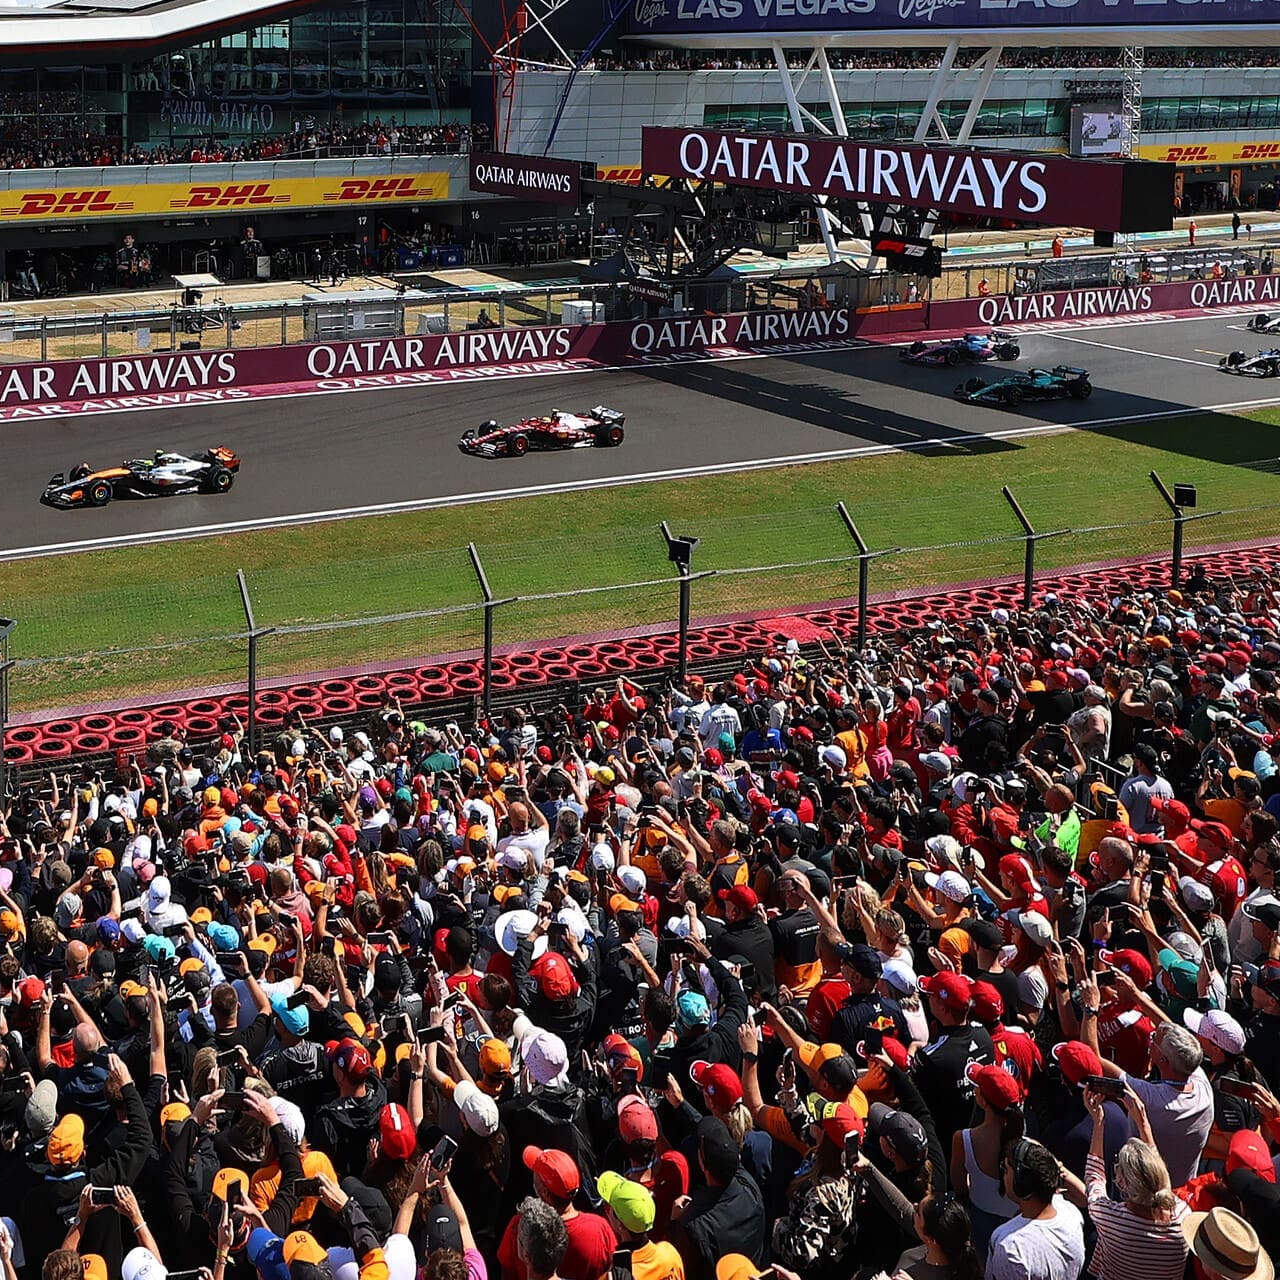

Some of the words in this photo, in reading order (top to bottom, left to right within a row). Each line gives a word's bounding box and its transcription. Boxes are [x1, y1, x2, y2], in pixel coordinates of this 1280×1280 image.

[1166, 147, 1210, 161] DHL
[1240, 144, 1280, 159] DHL
[476, 165, 514, 184] QATAR
[517, 170, 570, 192] AIRWAYS
[680, 134, 811, 186] QATAR
[824, 146, 1046, 212] AIRWAYS
[186, 184, 276, 207] DHL
[339, 178, 420, 200] DHL
[20, 191, 117, 216] DHL
[471, 210, 480, 220] 16
[358, 216, 367, 225] 17
[979, 295, 1055, 324] QATAR
[1062, 287, 1151, 316] AIRWAYS
[1191, 280, 1255, 307] QATAR
[632, 319, 727, 351] QATAR
[736, 309, 848, 342] AIRWAYS
[308, 340, 424, 377] QATAR
[435, 329, 569, 365] AIRWAYS
[69, 353, 235, 395] AIRWAYS
[316, 372, 440, 389] QATAR
[75, 388, 250, 411] AIRWAYS
